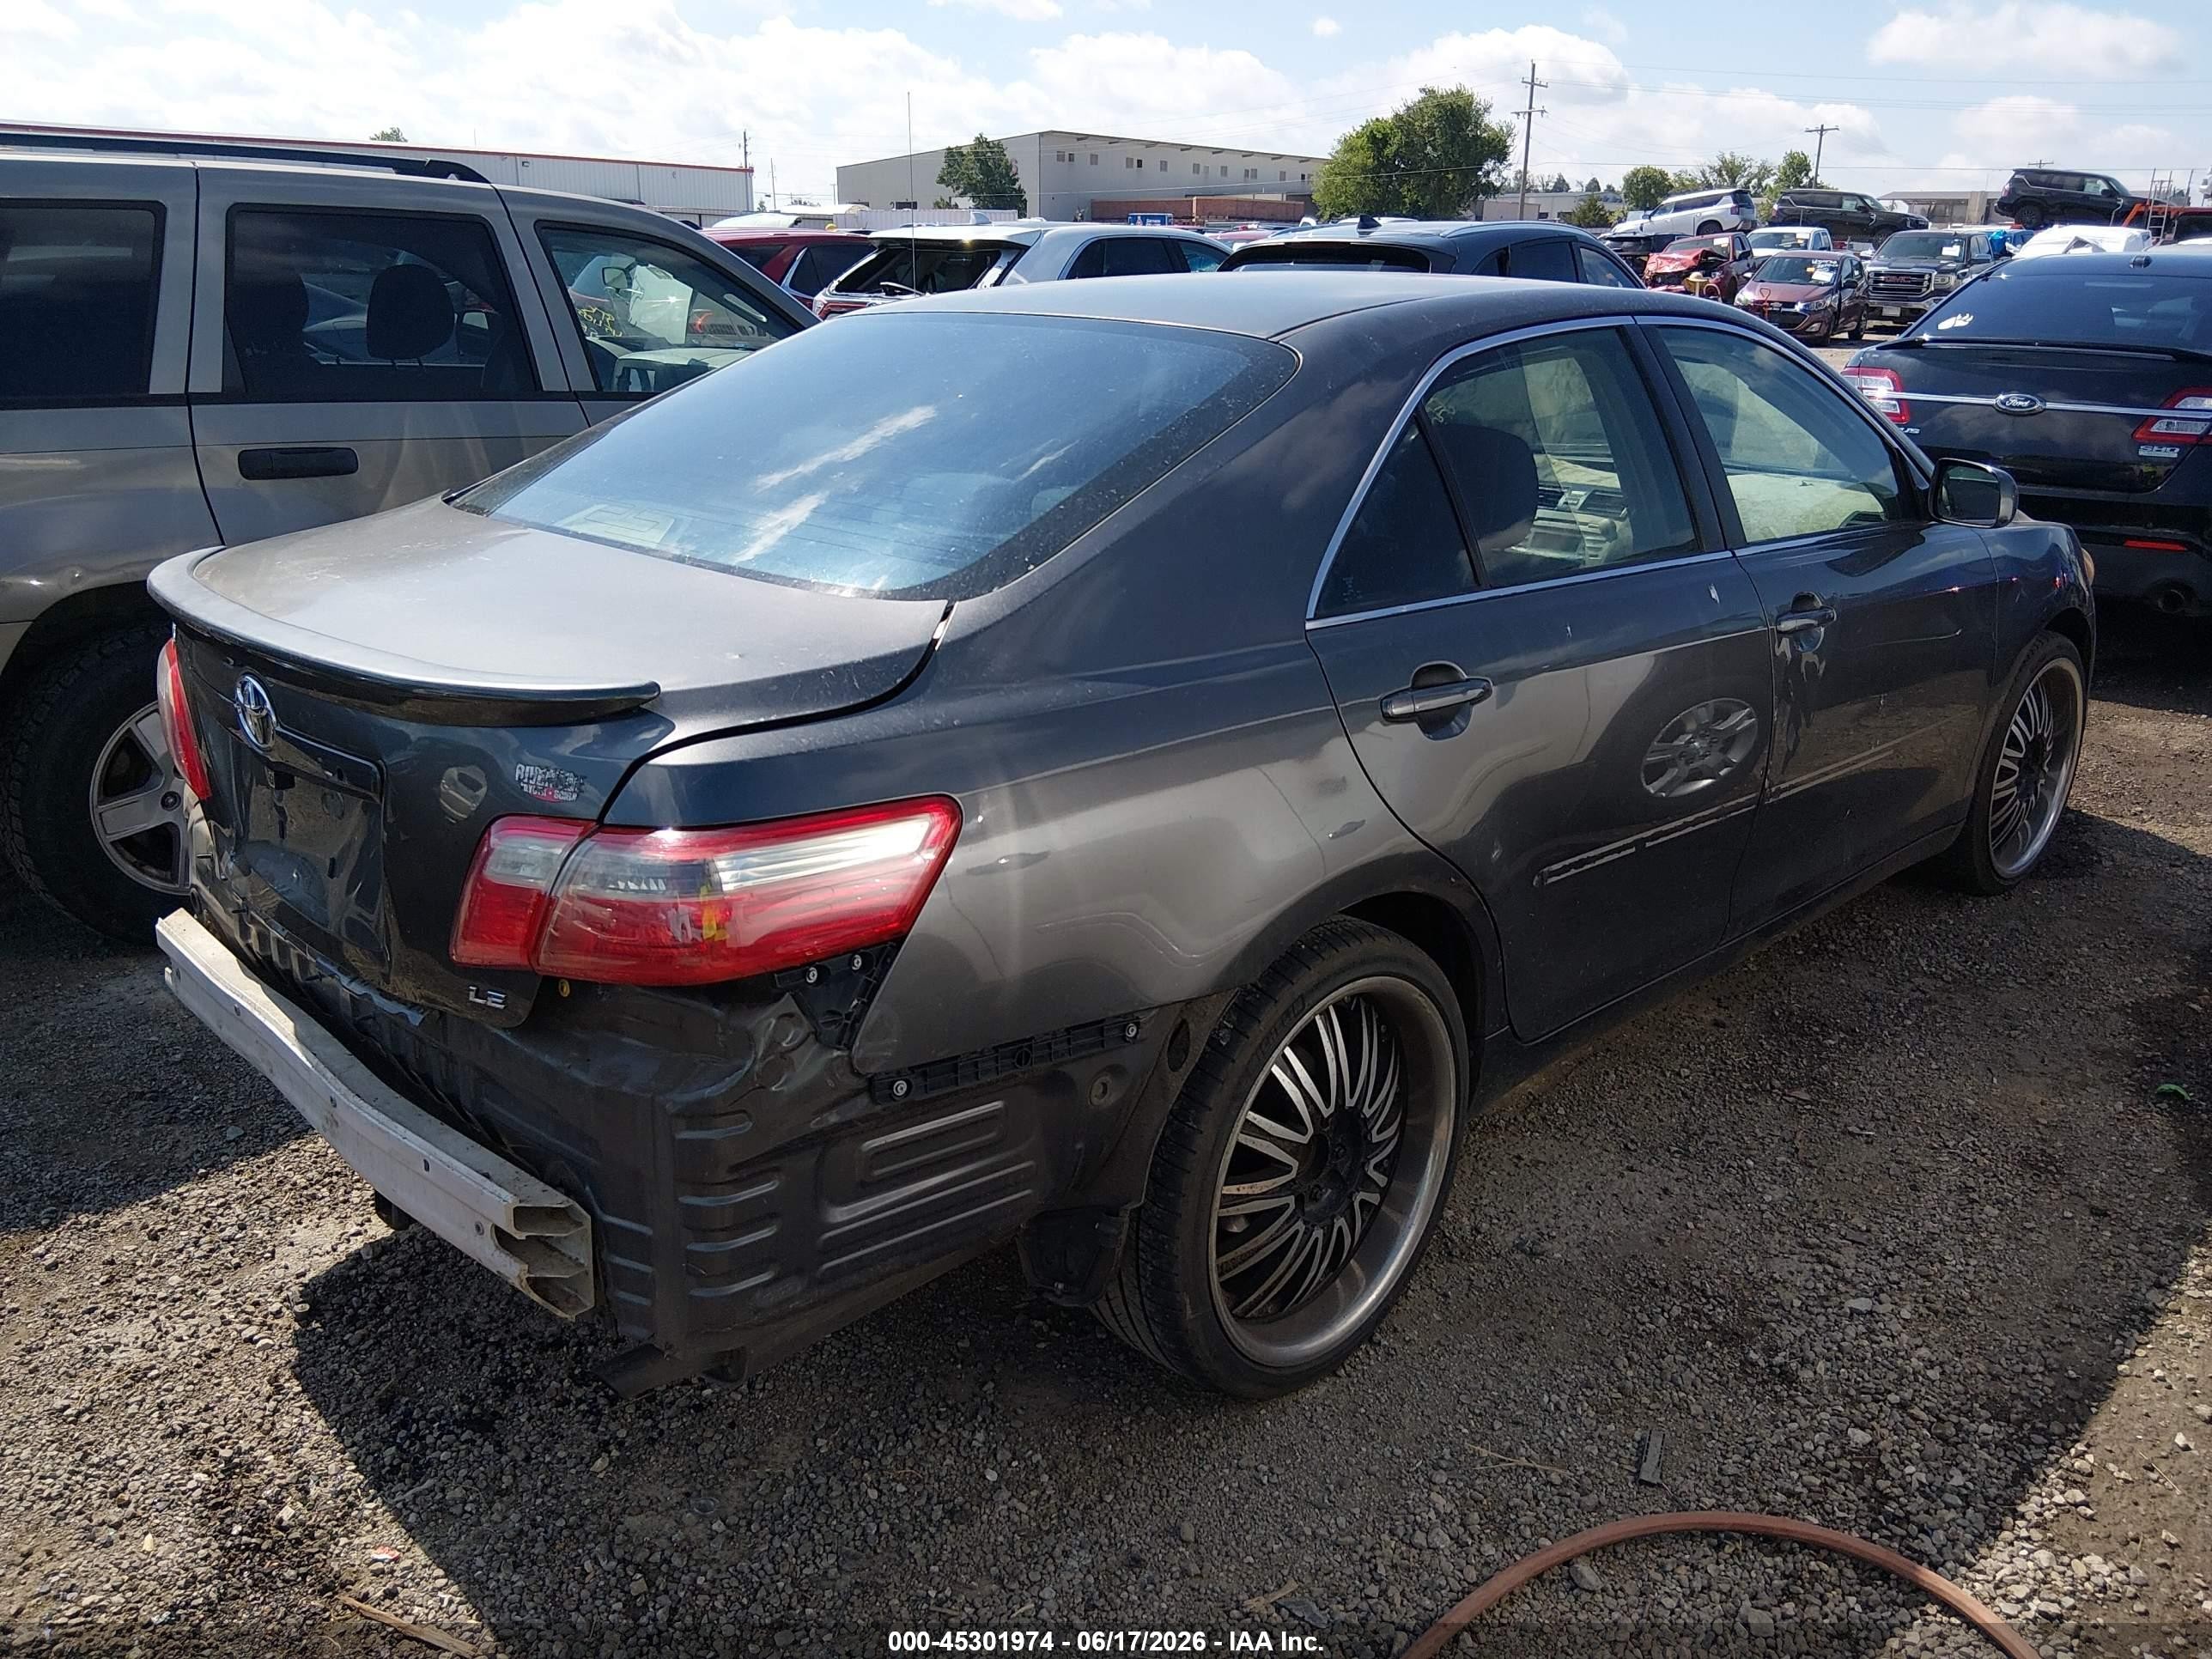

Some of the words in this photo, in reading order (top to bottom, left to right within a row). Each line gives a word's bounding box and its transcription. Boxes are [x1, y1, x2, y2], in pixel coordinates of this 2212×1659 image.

[2005, 396, 2031, 407] Ford
[2139, 445, 2180, 453] SHO
[469, 986, 507, 1010] LE
